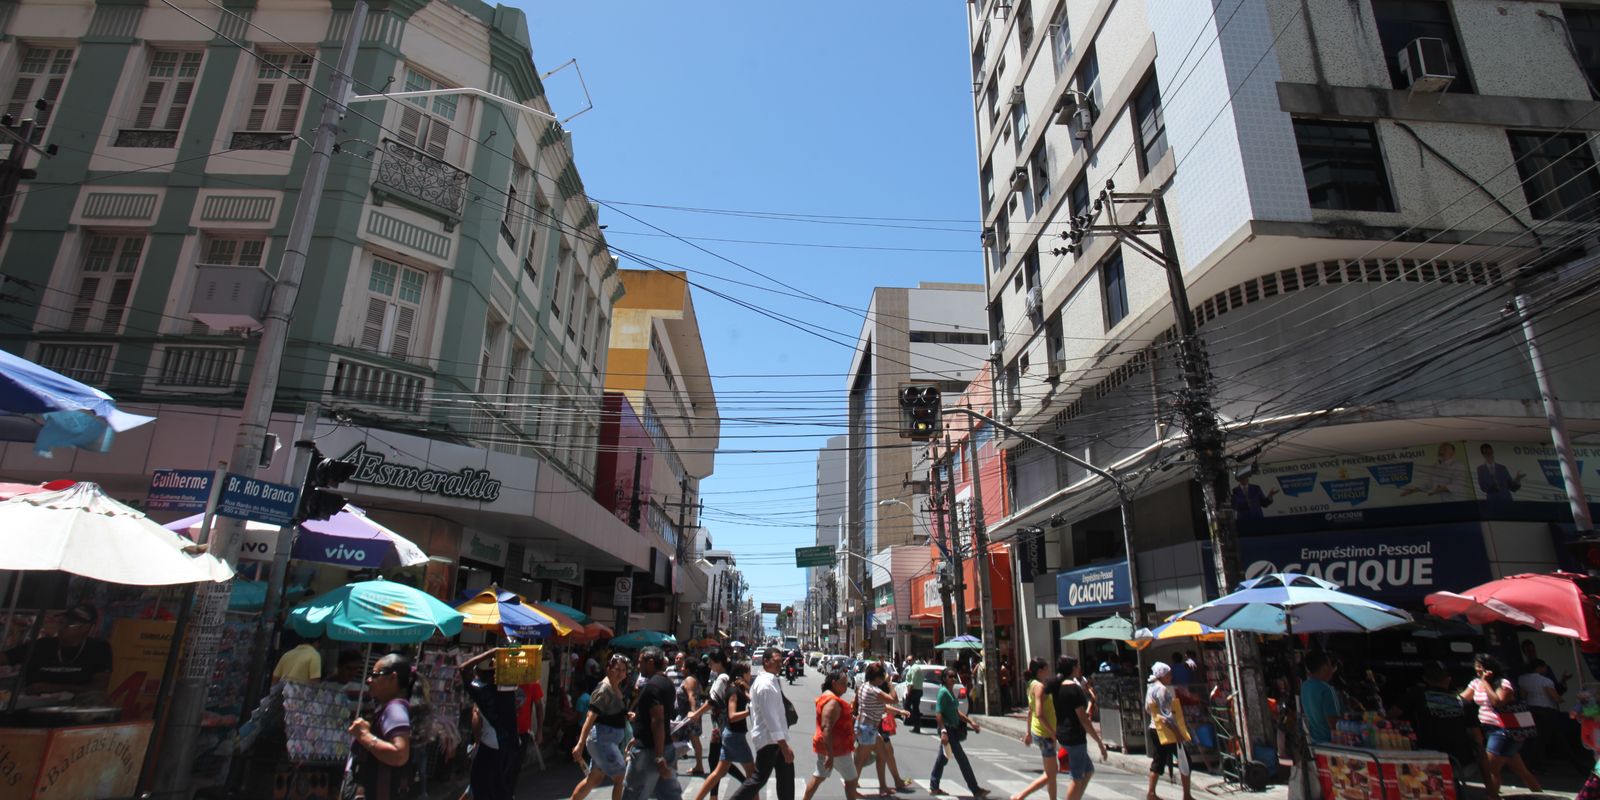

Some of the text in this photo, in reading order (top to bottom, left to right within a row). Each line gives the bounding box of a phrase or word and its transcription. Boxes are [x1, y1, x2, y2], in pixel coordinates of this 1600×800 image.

[1523, 446, 1557, 457] DINHEI
[1300, 462, 1317, 472] QUE
[1318, 458, 1340, 469] VOCÊ
[152, 472, 208, 490] Guilherme
[228, 476, 295, 504] Br. Rio Branco
[1333, 511, 1363, 520] CACIQUE
[241, 541, 268, 553] ivo
[324, 543, 366, 561] vivo
[1300, 541, 1431, 561] Empréstimo Pessoal
[1078, 581, 1114, 604] CACIQUE
